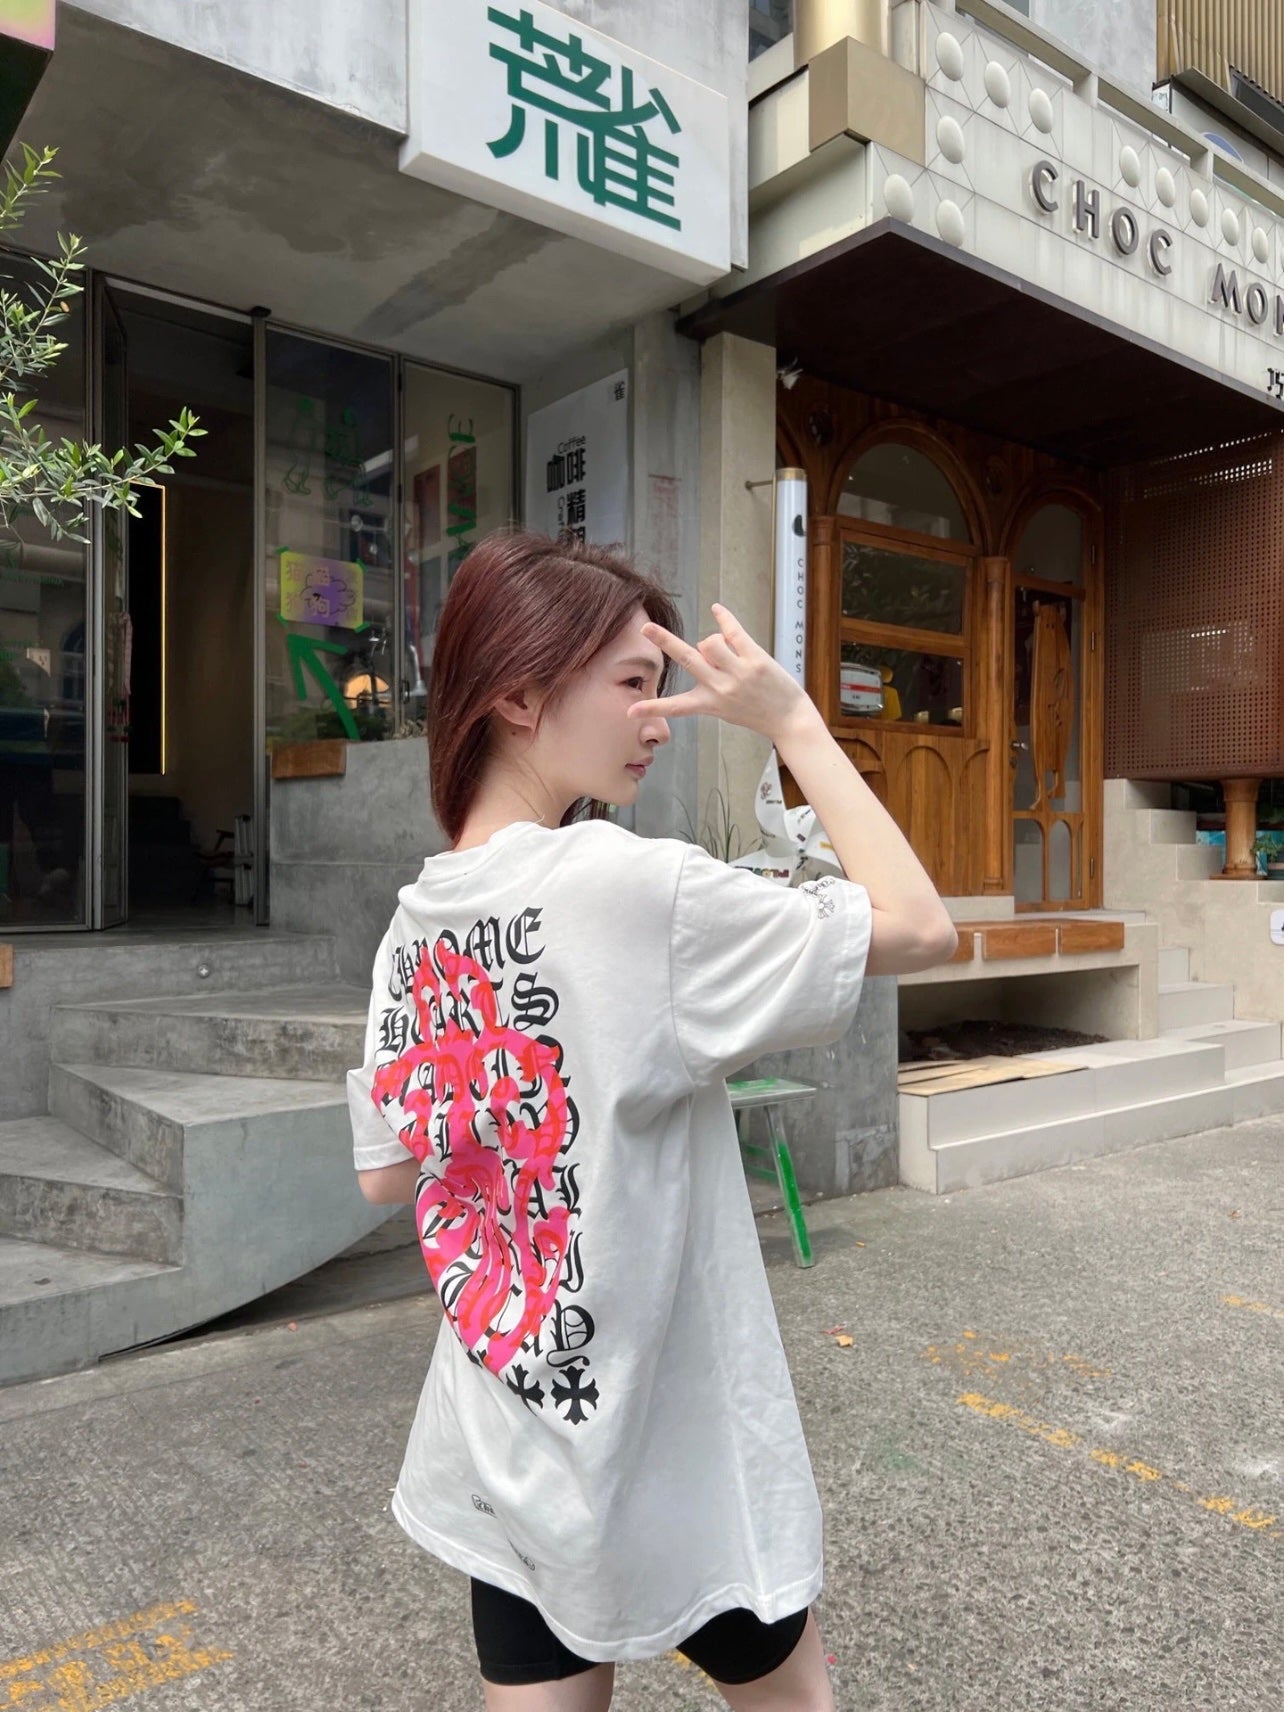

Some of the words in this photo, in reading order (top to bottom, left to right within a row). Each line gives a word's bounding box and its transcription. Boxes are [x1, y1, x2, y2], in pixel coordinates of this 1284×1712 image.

[1031, 160, 1173, 277] CHOC
[546, 447, 587, 493] 咖啡
[556, 435, 587, 455] Coffee
[796, 557, 805, 609] CHOC
[794, 620, 804, 673] MONS
